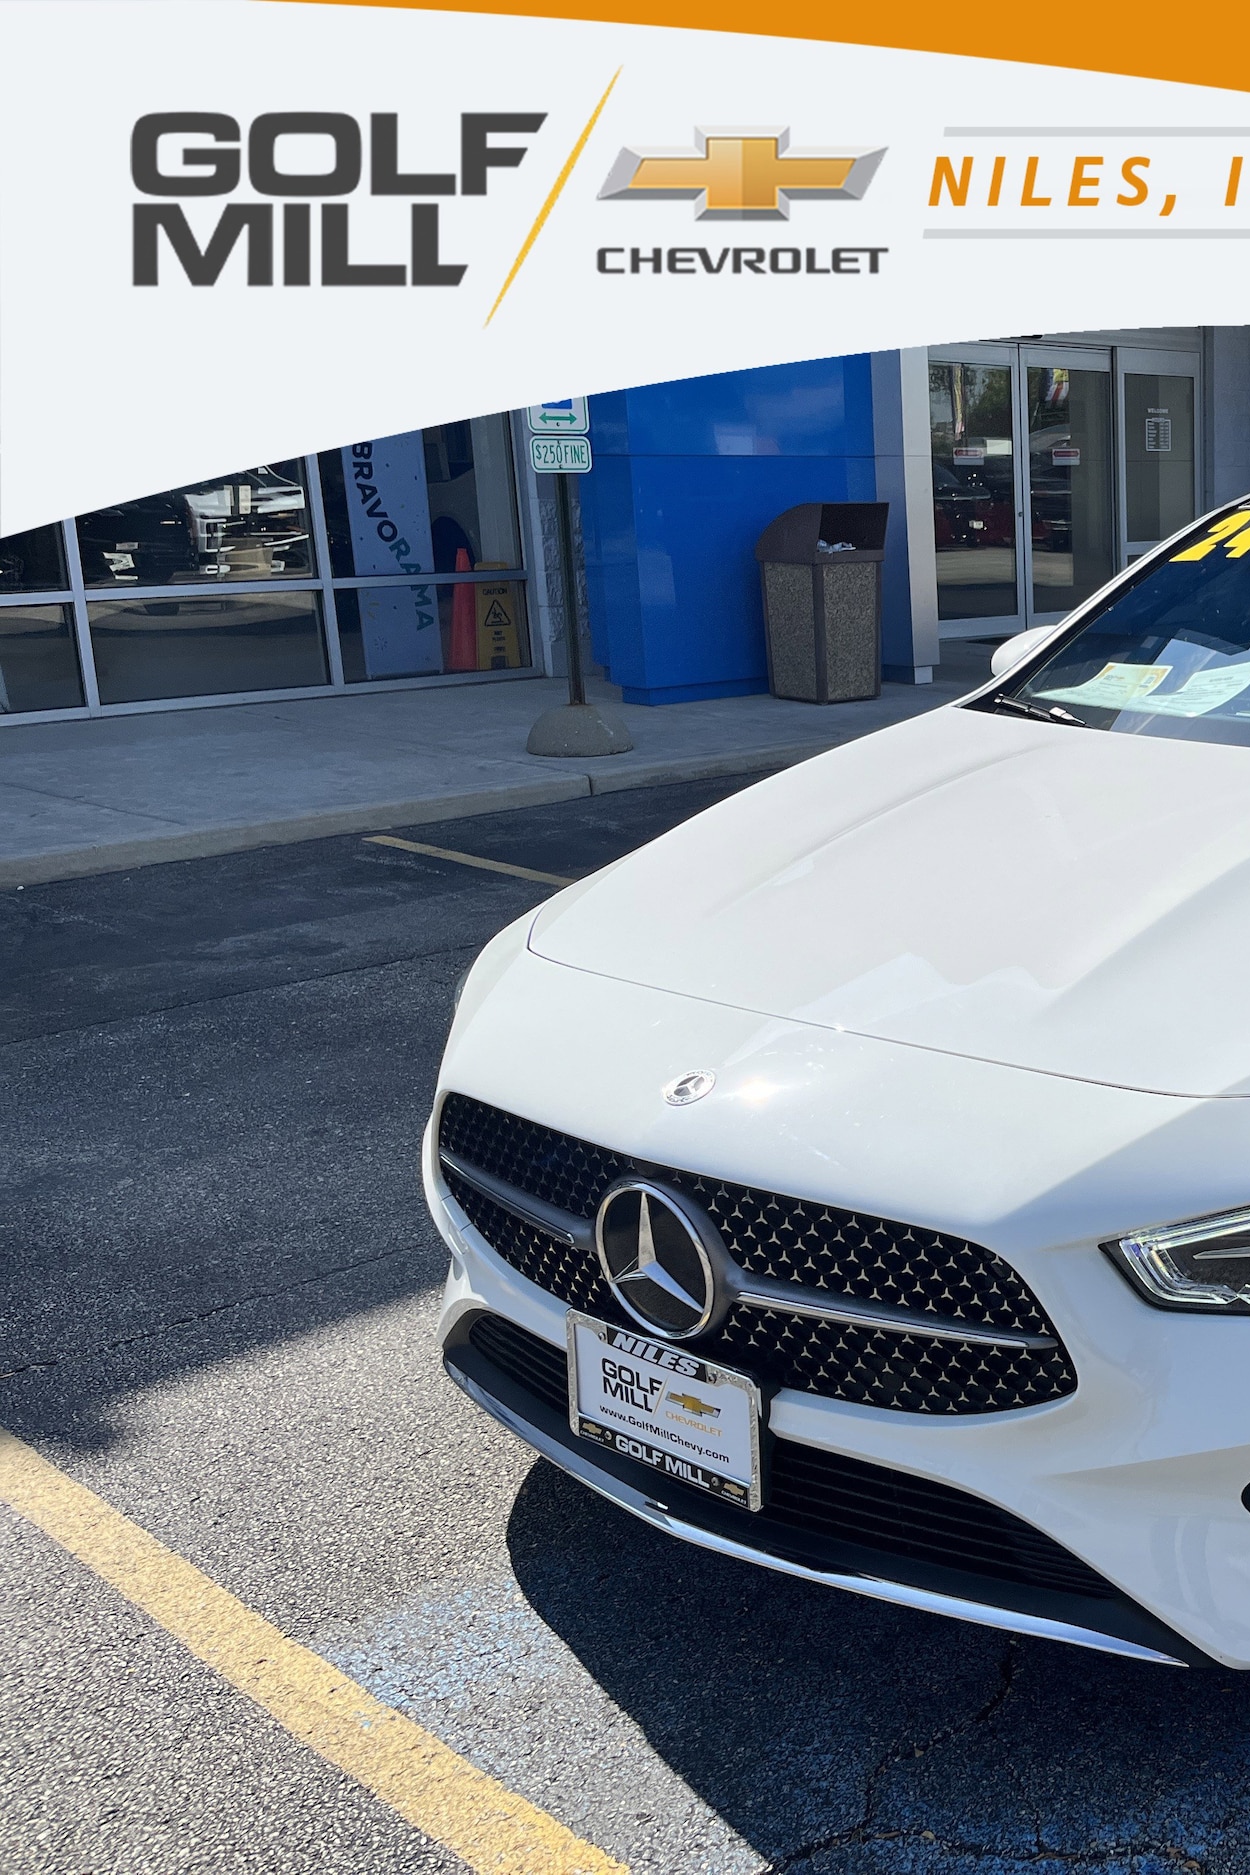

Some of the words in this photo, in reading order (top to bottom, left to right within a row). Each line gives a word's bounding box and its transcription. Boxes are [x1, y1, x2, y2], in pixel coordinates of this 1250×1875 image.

[535, 444, 563, 464] $250
[564, 444, 587, 464] FINE
[482, 587, 508, 596] CAUTION
[612, 1332, 700, 1377] NILES
[602, 1357, 663, 1396] GOLF
[603, 1376, 654, 1413] MILL
[599, 1405, 730, 1463] www.GolfMillChevy.com
[665, 1410, 723, 1438] CHEVROLET
[615, 1434, 664, 1466] GOLF
[665, 1455, 711, 1489] MILL
